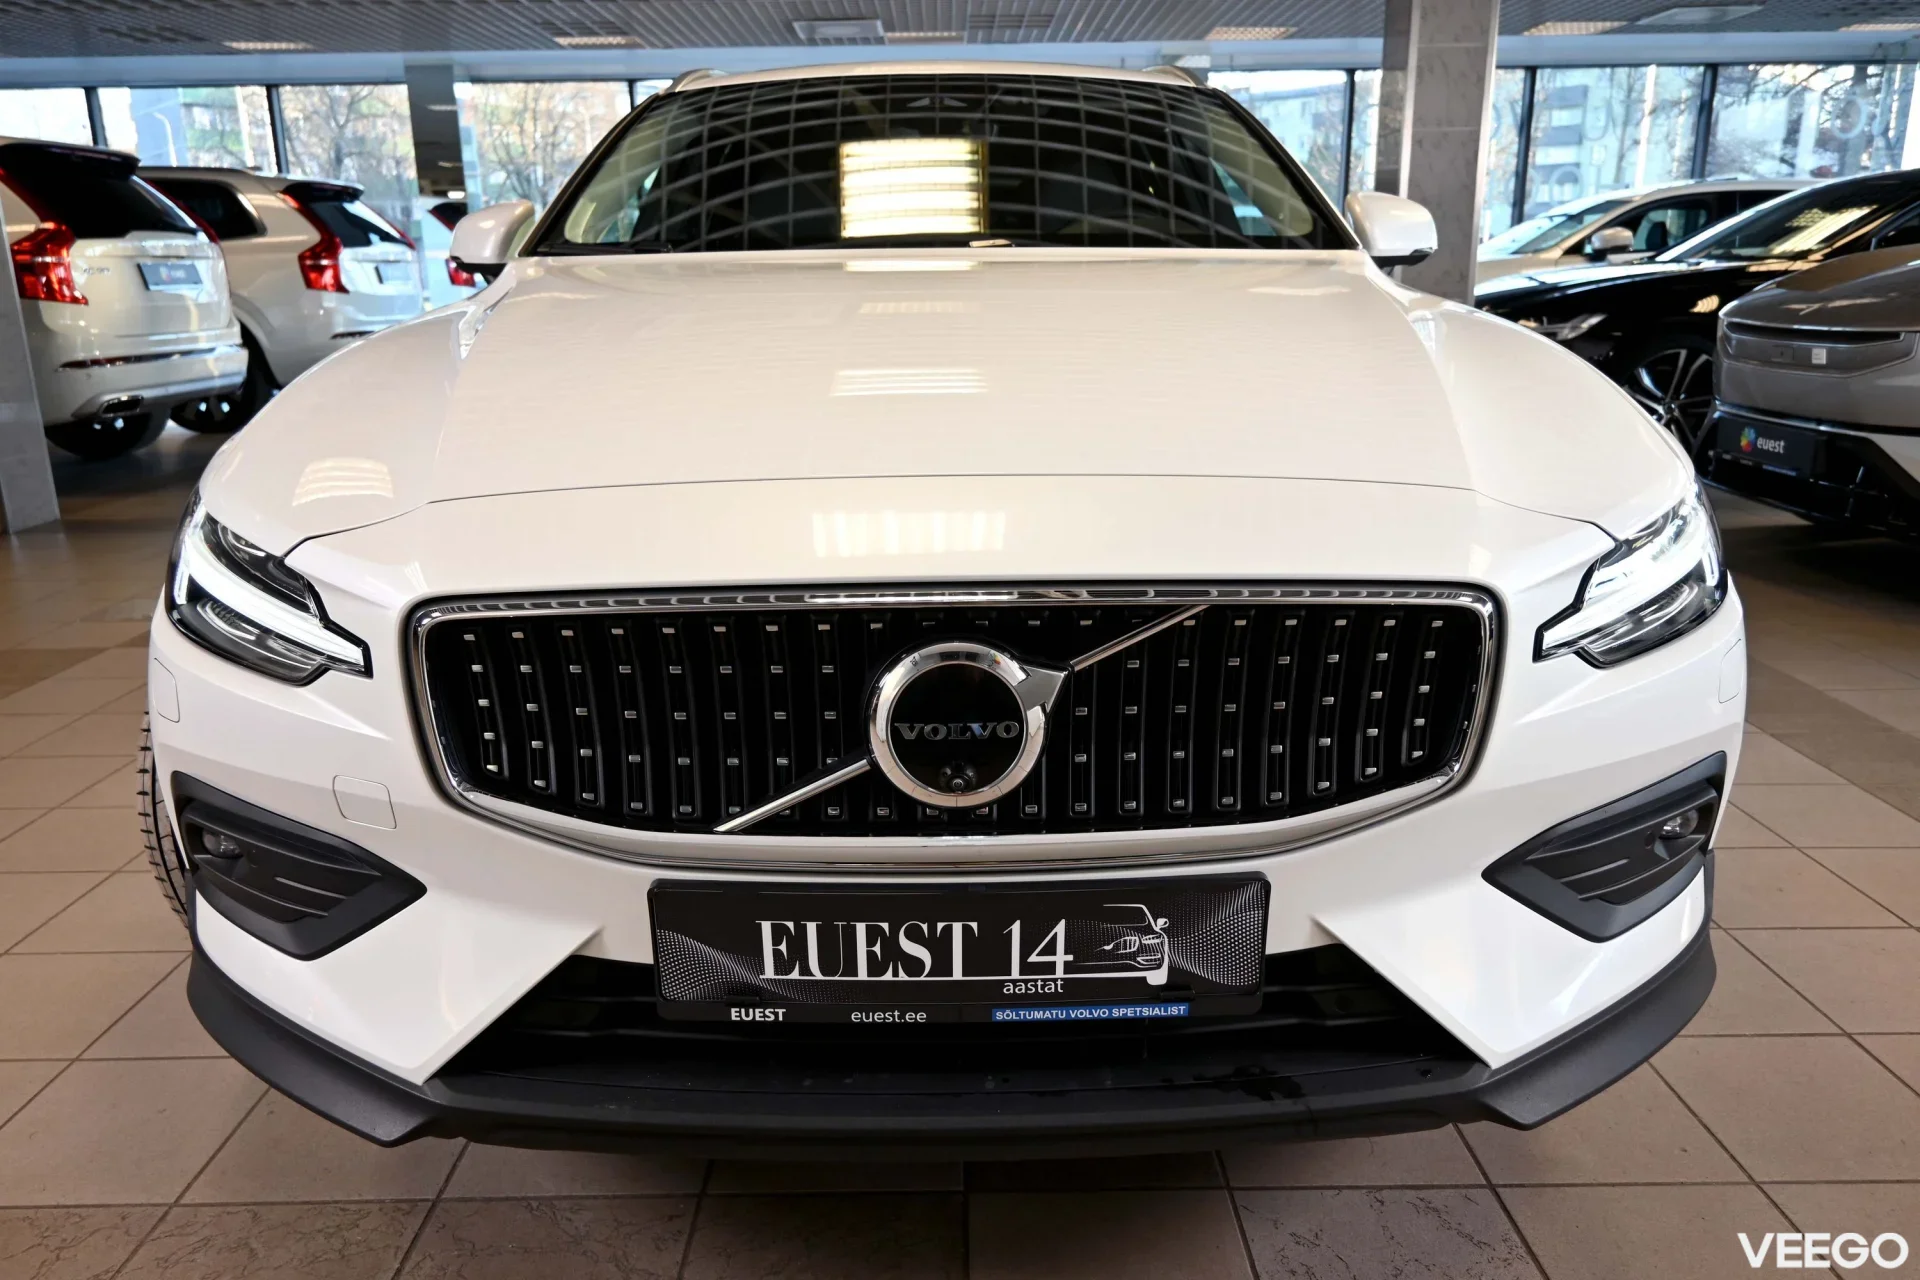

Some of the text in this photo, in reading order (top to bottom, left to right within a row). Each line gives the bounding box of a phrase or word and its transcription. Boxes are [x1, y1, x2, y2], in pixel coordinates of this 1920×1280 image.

[1757, 437, 1785, 454] euest
[894, 721, 1020, 740] VOLVO
[755, 918, 1074, 979] EUEST 14
[1002, 979, 1064, 994] aastat
[730, 1007, 787, 1021] EUEST
[850, 1009, 927, 1023] euest.ee
[995, 1006, 1187, 1020] SÕLTUMATU VOLVO SPETSIALIST
